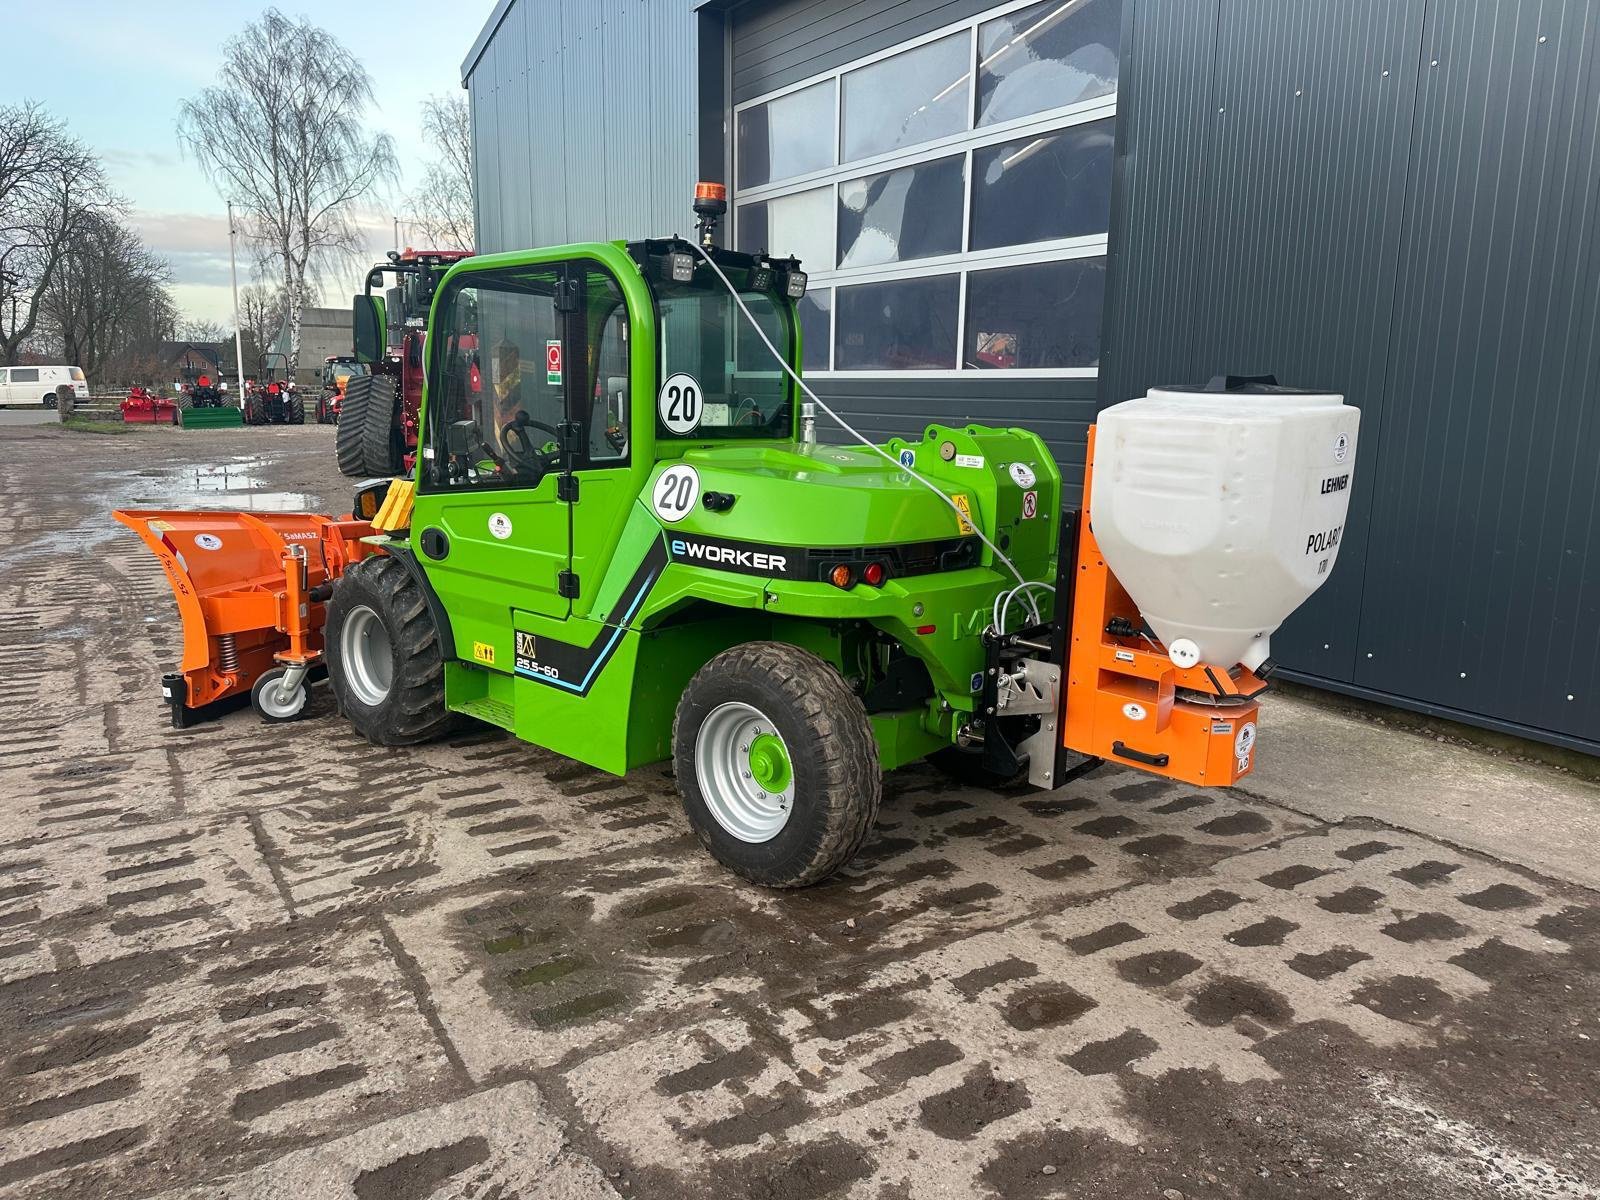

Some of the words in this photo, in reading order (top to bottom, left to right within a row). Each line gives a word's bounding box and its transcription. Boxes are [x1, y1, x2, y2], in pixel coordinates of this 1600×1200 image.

[668, 386, 696, 422] 20
[659, 473, 693, 512] 20
[1321, 474, 1349, 495] LEHNER
[516, 657, 559, 679] 25.5-60
